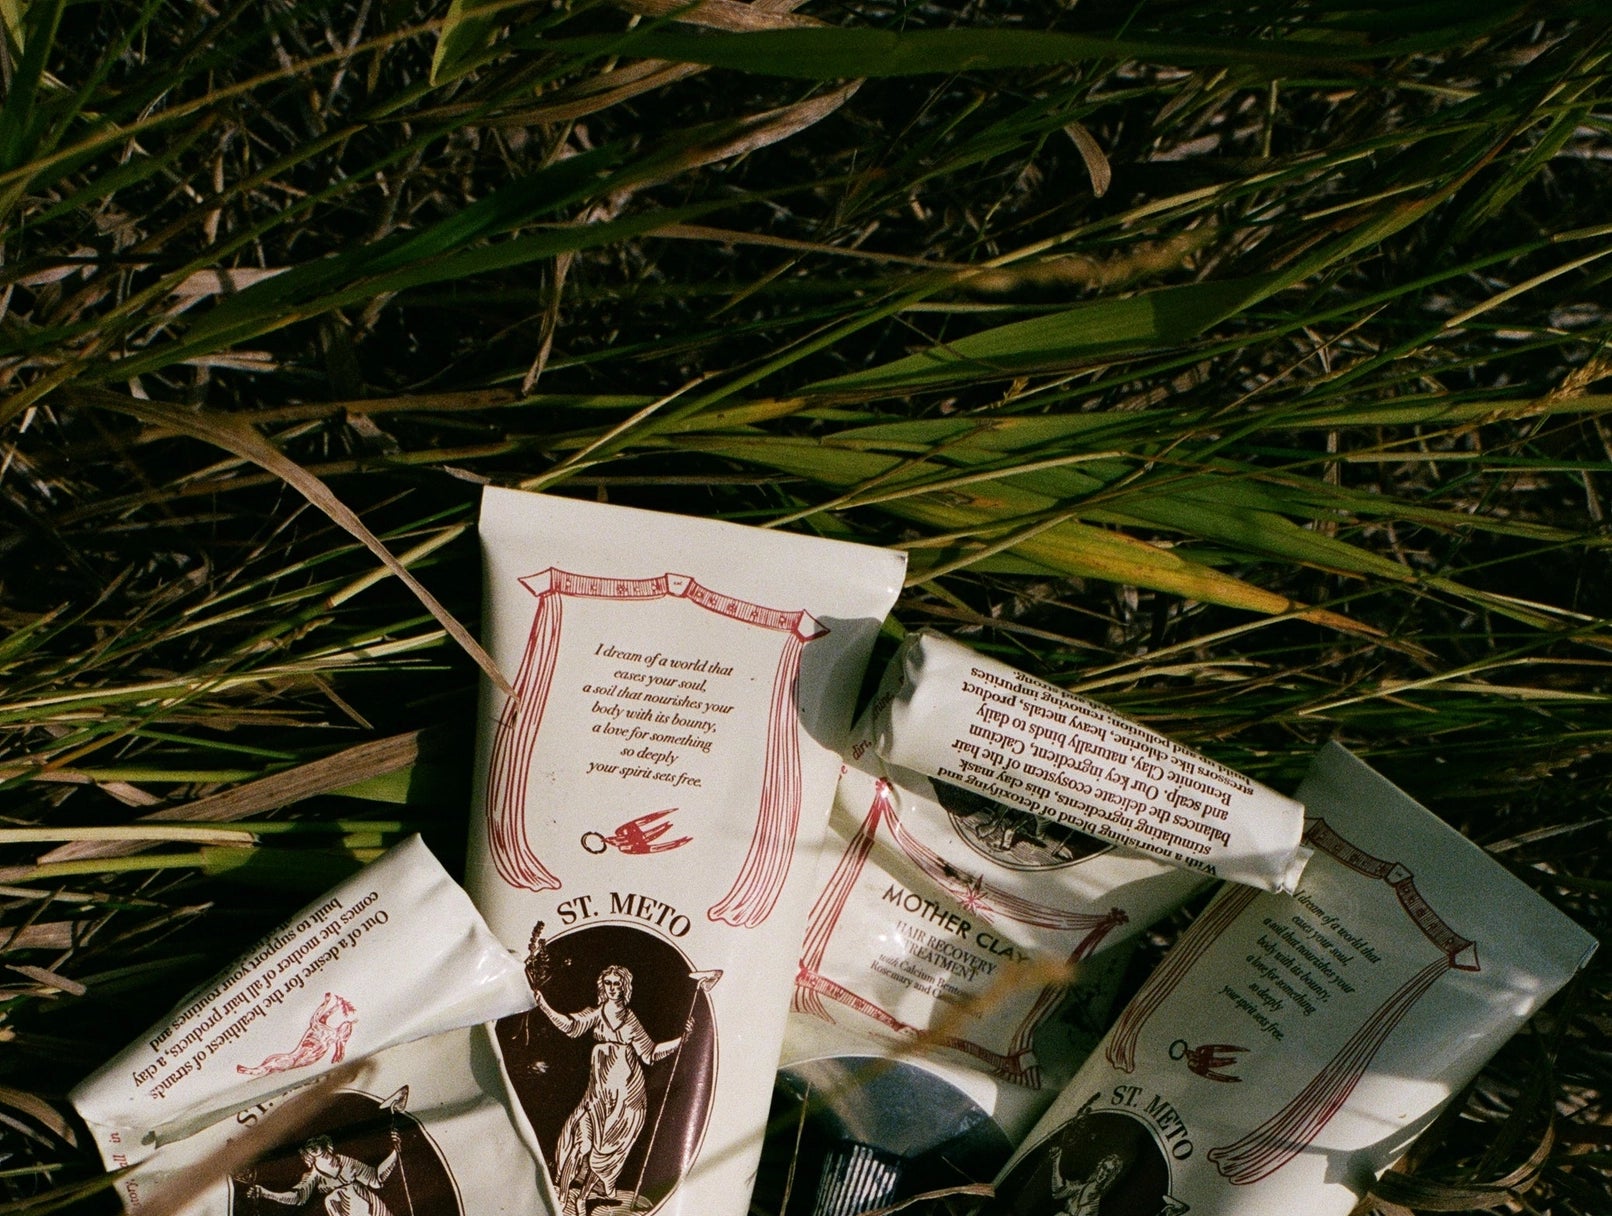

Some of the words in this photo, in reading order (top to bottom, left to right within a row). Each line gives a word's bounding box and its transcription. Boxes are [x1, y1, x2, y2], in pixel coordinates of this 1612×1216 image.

[594, 643, 603, 656] I
[603, 646, 642, 662] dream
[644, 653, 661, 667] of
[659, 658, 668, 666] a
[670, 659, 708, 672] world
[708, 661, 734, 676] that
[614, 670, 646, 682] eases
[647, 674, 678, 686] your
[678, 679, 707, 693] soul,
[961, 682, 1017, 706] product
[971, 668, 1039, 701] impurities
[583, 683, 592, 692] a
[592, 684, 615, 695] soil
[617, 686, 643, 700] that
[643, 693, 703, 709] nourishes
[702, 701, 734, 714] your
[1020, 698, 1067, 723] metals,
[1041, 690, 1104, 721] removing
[591, 701, 624, 720] body
[626, 708, 652, 722] with
[655, 712, 670, 724] its
[671, 713, 717, 734] bounty,
[976, 703, 1009, 727] daily
[1012, 718, 1026, 730] to
[592, 723, 601, 732] a
[603, 722, 629, 736] love
[626, 727, 649, 741] for
[649, 733, 713, 754] something
[969, 724, 1025, 754] Calcium
[1029, 723, 1067, 748] binds
[1069, 715, 1106, 741] heavy
[620, 747, 634, 756] so
[637, 747, 679, 767] deeply
[952, 739, 980, 758] hair
[982, 748, 1004, 765] the
[1068, 734, 1128, 764] naturally
[1110, 730, 1168, 760] chlorine,
[937, 767, 963, 780] and
[959, 759, 995, 777] mask
[1002, 758, 1021, 771] of
[1030, 742, 1104, 781] ingredient,
[1132, 756, 1164, 781] Clay,
[1171, 756, 1194, 774] like
[586, 761, 619, 774] your
[619, 766, 652, 779] spirit
[652, 771, 676, 782] sets
[673, 772, 702, 788] free.
[996, 771, 1023, 787] clay
[1024, 764, 1092, 794] ecosystem
[1105, 768, 1130, 790] key
[1198, 768, 1254, 795] stressors
[965, 775, 1040, 811] detoxifying
[1026, 782, 1050, 799] this
[1131, 780, 1159, 800] Our
[1164, 788, 1202, 811] scalp.
[1168, 771, 1232, 806] Bentonite
[1040, 805, 1056, 816] of
[1054, 791, 1134, 831] ingredients,
[1094, 788, 1146, 815] delicate
[1201, 804, 1228, 820] and
[1058, 812, 1096, 834] blend
[1149, 806, 1171, 824] the
[1098, 825, 1172, 857] nourishing
[1135, 818, 1212, 855] stimulating
[1173, 814, 1231, 847] balances
[310, 897, 343, 923] built
[341, 891, 378, 924] comes
[557, 895, 598, 925] ST.
[610, 892, 691, 938] METO
[296, 920, 311, 933] to
[320, 921, 341, 939] the
[361, 910, 389, 932] Out
[882, 884, 971, 939] MOTHER
[976, 932, 1030, 964] CLAY
[249, 930, 296, 969] support
[338, 939, 348, 948] a
[348, 928, 362, 948] of
[1311, 931, 1334, 949] your
[278, 936, 320, 973] mother
[302, 946, 340, 978] desire
[928, 935, 998, 975] RECOVERY
[223, 963, 251, 991] your
[246, 979, 263, 999] all
[262, 969, 276, 988] of
[284, 974, 304, 993] for
[172, 991, 222, 1030] routines
[223, 992, 251, 1015] hair
[263, 989, 285, 1008] the
[149, 1030, 173, 1052] and
[165, 1006, 223, 1057] products,
[205, 1004, 267, 1054] healthiest
[157, 1056, 167, 1067] a
[192, 1051, 207, 1070] of
[132, 1064, 158, 1087] clay
[149, 1061, 193, 1099] strands
[1111, 1085, 1143, 1107] ST.
[1144, 1094, 1194, 1161] METO
